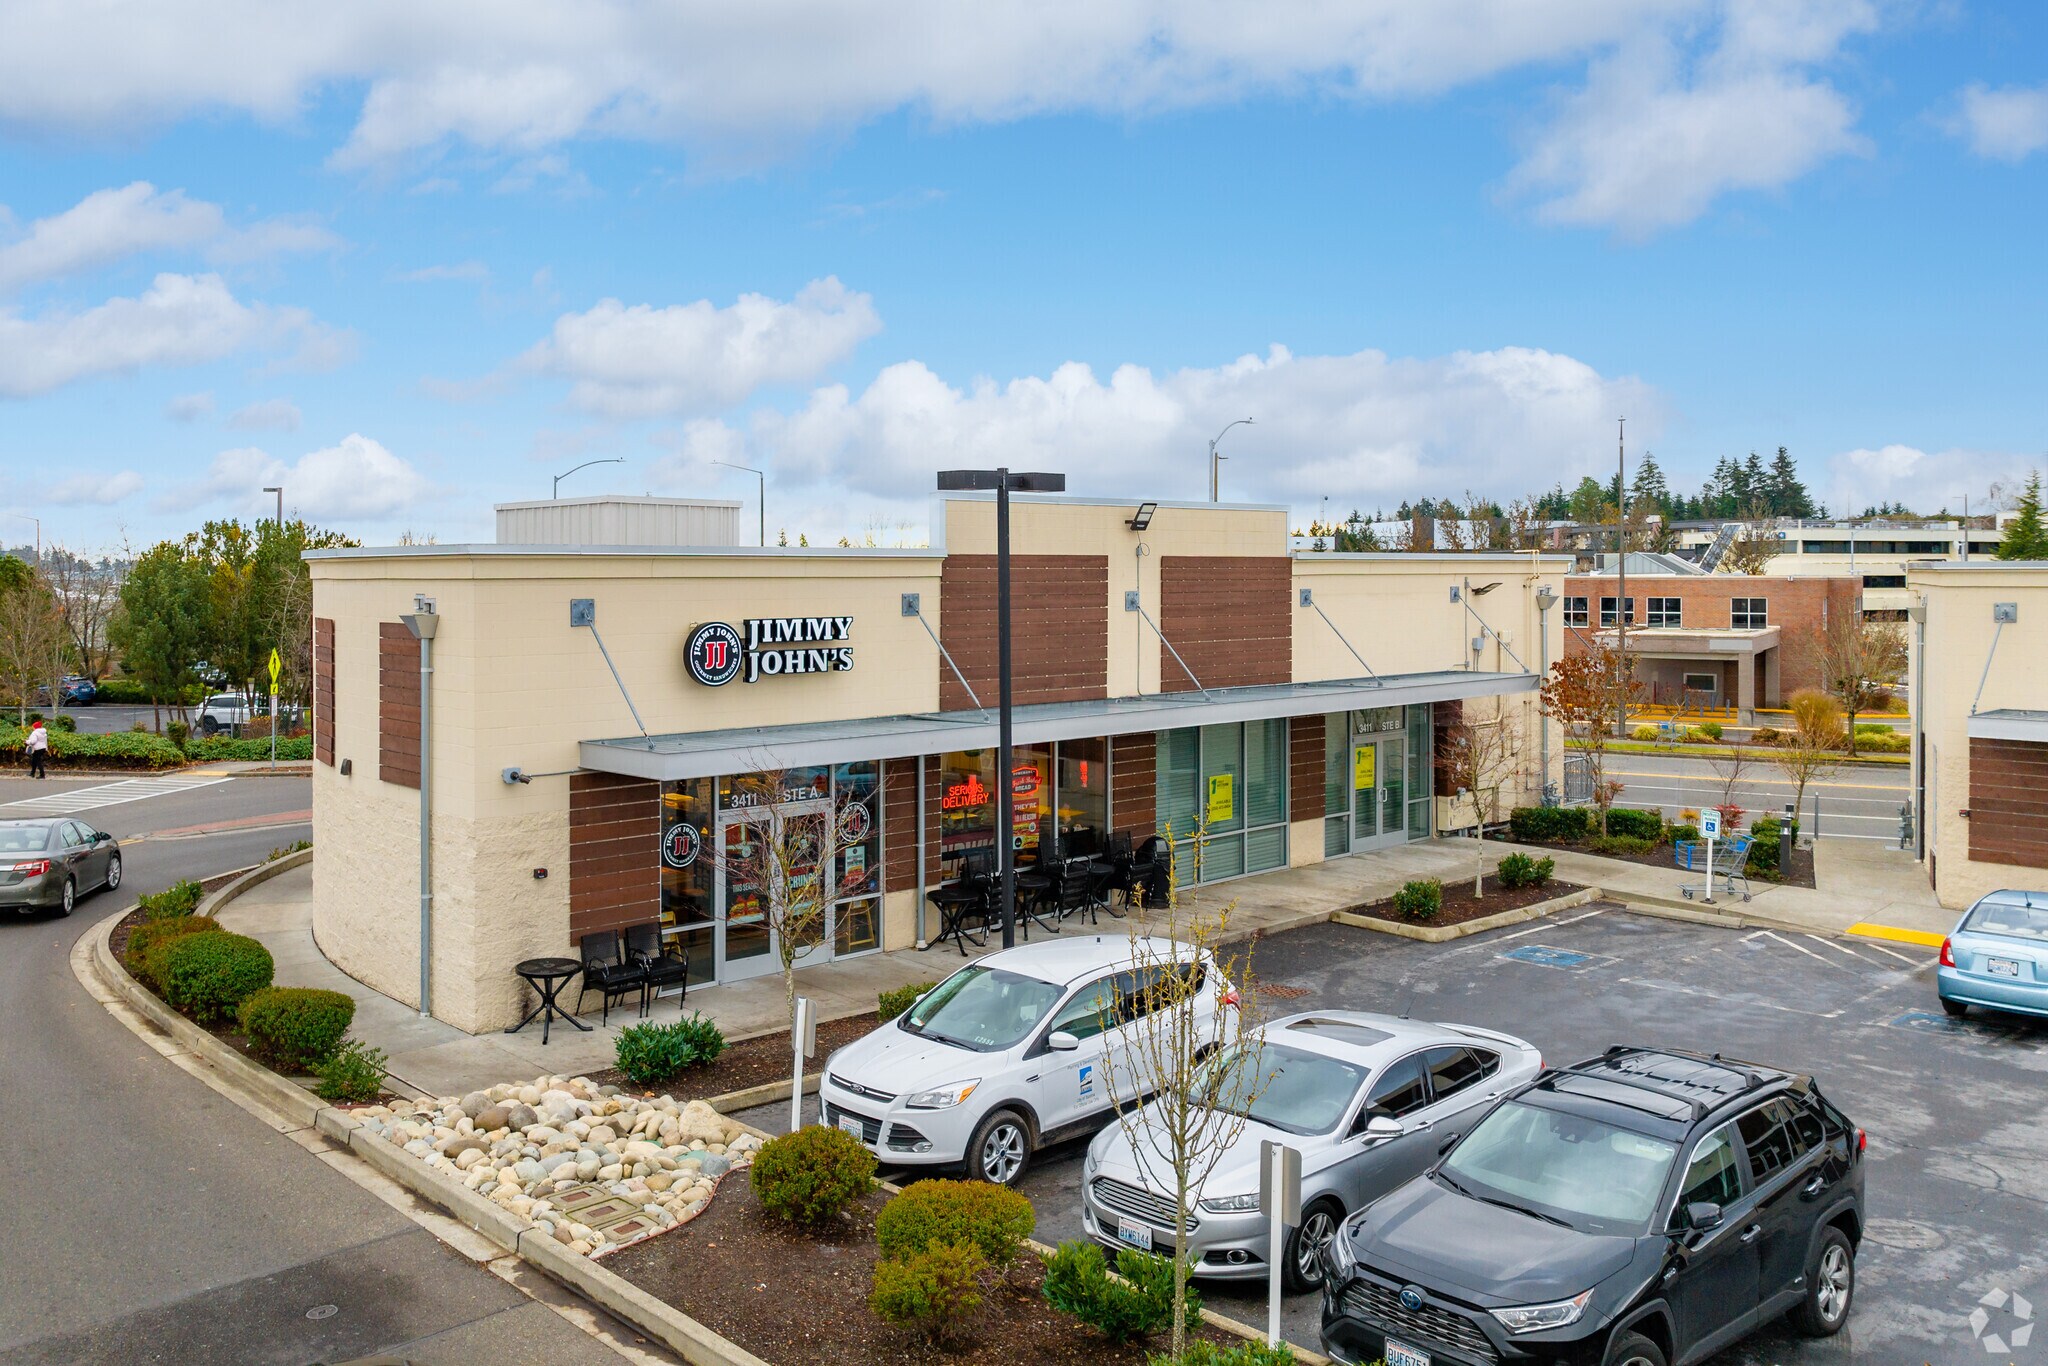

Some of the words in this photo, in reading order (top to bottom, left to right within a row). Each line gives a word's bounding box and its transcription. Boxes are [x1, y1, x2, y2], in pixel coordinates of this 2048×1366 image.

[693, 627, 715, 656] JIMMY
[716, 627, 738, 655] JOHN'S
[748, 617, 853, 651] JIMMY
[704, 641, 728, 670] JJ
[748, 648, 853, 683] JOHN'S
[1359, 722, 1373, 733] 3411
[1382, 721, 1393, 731] STE
[1394, 720, 1400, 729] B
[731, 792, 758, 808] 3411
[783, 787, 806, 802] STE
[809, 785, 818, 798] A
[943, 792, 989, 809] DELIVERY
[949, 783, 984, 797] SERIOUS
[673, 835, 691, 856] JJ
